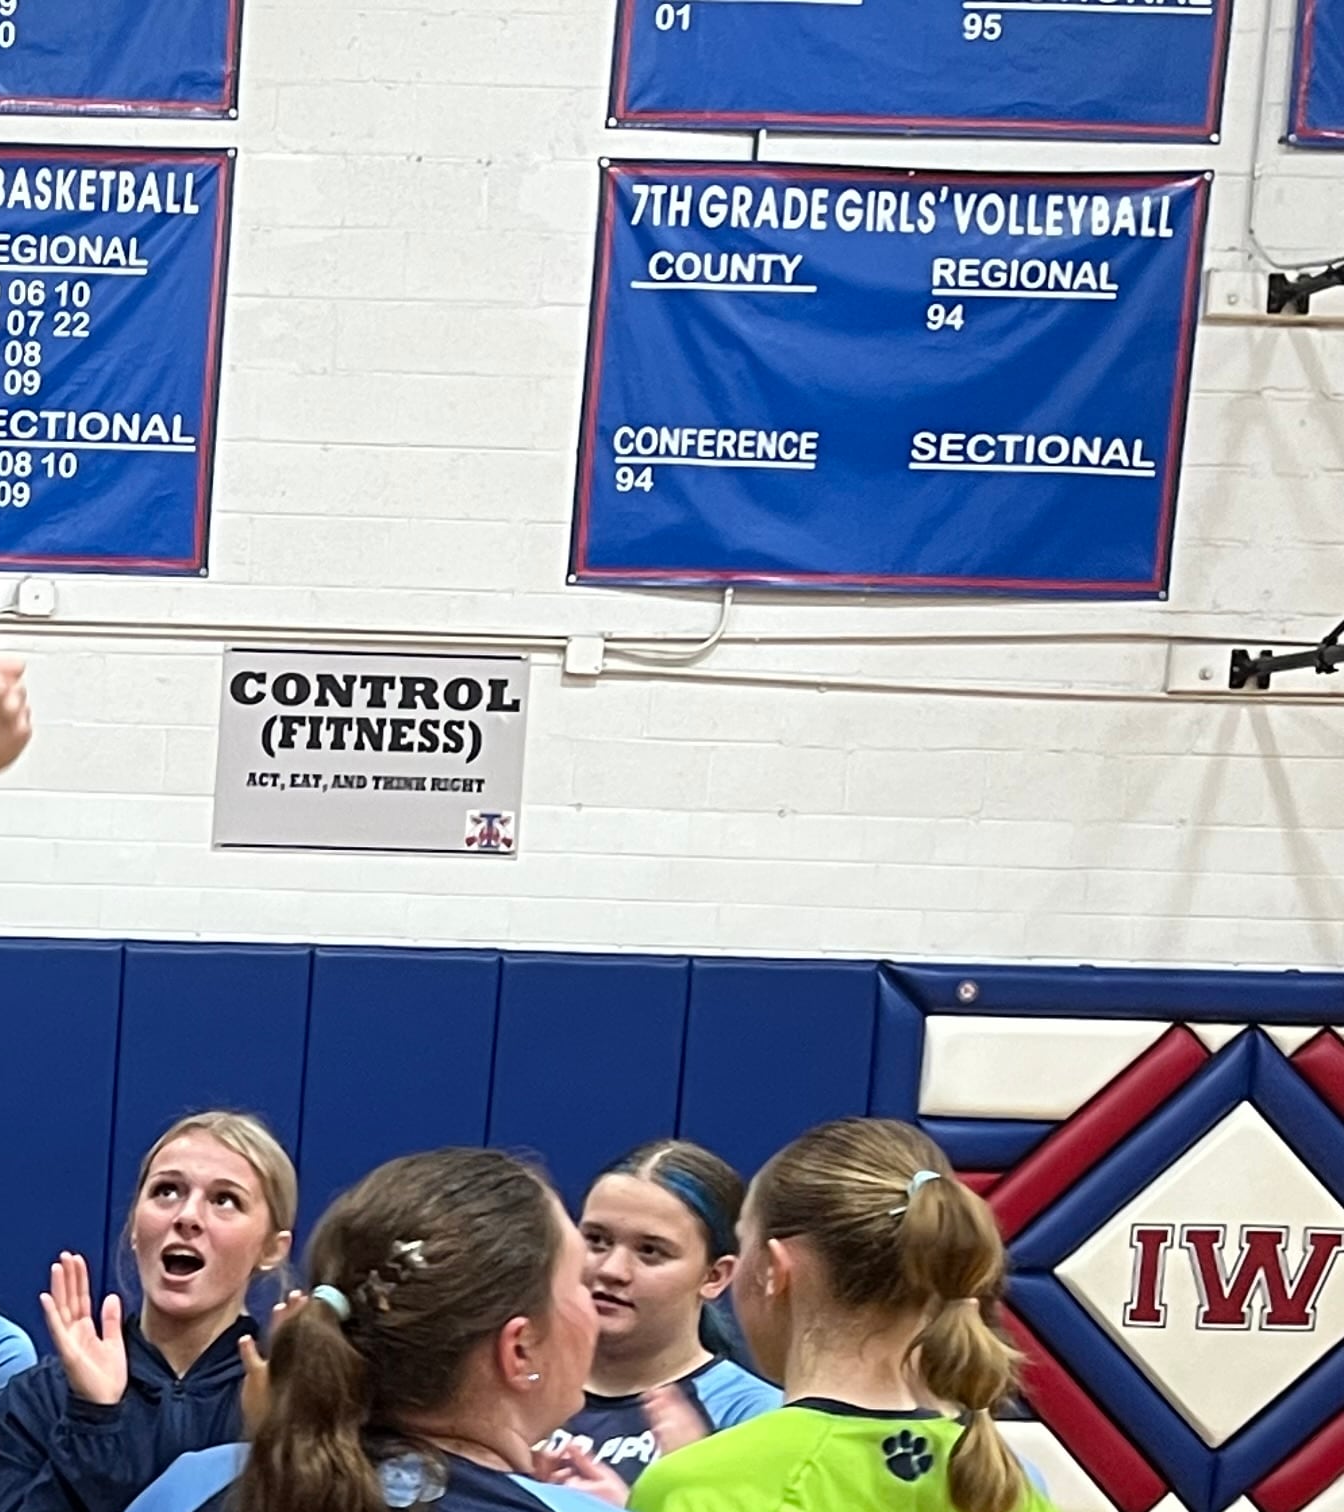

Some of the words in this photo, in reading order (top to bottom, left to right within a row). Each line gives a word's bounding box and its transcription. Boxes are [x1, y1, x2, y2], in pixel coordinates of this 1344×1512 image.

[655, 3, 691, 31] 01
[962, 12, 1002, 41] 95
[631, 184, 693, 227] 7TH
[698, 184, 829, 231] GRADE
[835, 185, 949, 234] GIRLS'
[953, 191, 1174, 239] VOLLEYBALL
[647, 250, 804, 285] COUNTY
[931, 257, 1119, 291] REGIONAL
[8, 279, 46, 307] 06
[54, 280, 91, 308] 10
[6, 309, 45, 337] 07
[52, 311, 90, 338] 22
[926, 303, 965, 331] 94
[4, 340, 41, 367] 08
[3, 368, 41, 396] 09
[613, 425, 819, 461] CONFERENCE
[911, 433, 1155, 468] SECTIONAL
[40, 452, 78, 478] 10
[615, 466, 654, 493] 94
[230, 671, 521, 712] CONTROL
[261, 714, 482, 764] (FITNESS)
[246, 772, 285, 791] ACT,
[289, 773, 328, 792] EAT,
[331, 775, 367, 790] AND
[372, 776, 426, 792] THINK
[430, 777, 485, 793] RIGHT
[1123, 1223, 1344, 1331] IW
